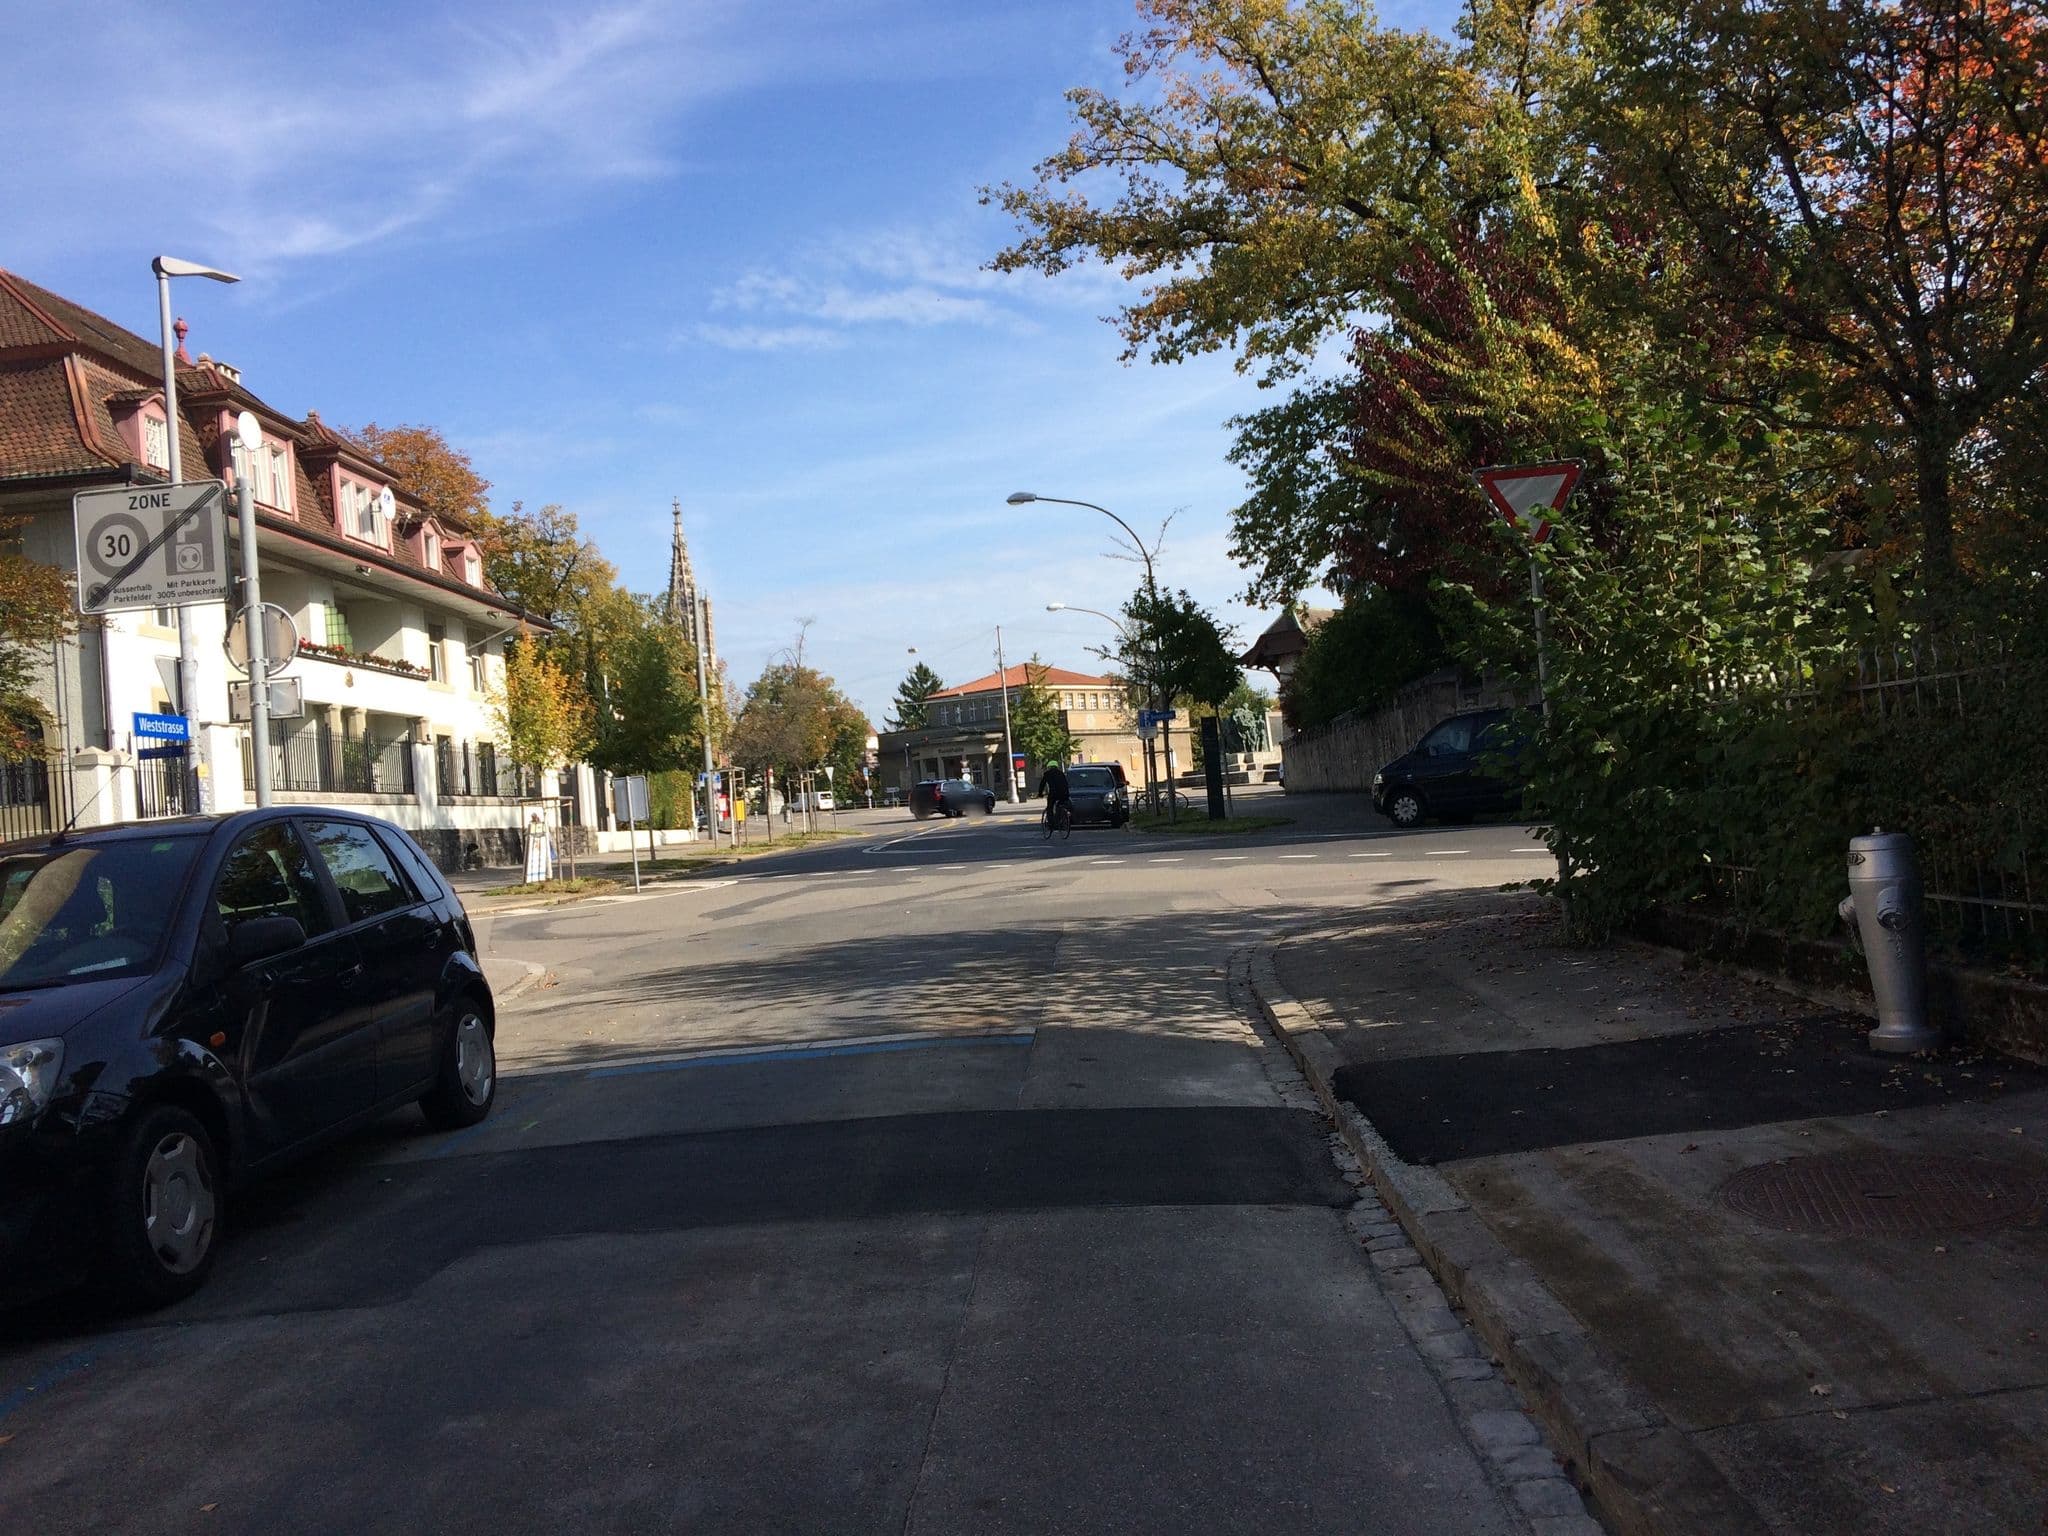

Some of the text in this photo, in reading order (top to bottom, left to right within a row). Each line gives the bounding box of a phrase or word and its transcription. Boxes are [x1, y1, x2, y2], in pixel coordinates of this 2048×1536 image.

[128, 493, 171, 511] ZONE
[104, 534, 131, 558] 30
[166, 577, 216, 589] Mit Parkkarte
[113, 592, 153, 604] Parkfelder
[156, 590, 177, 600] 3005
[138, 716, 185, 735] Weststrasse
